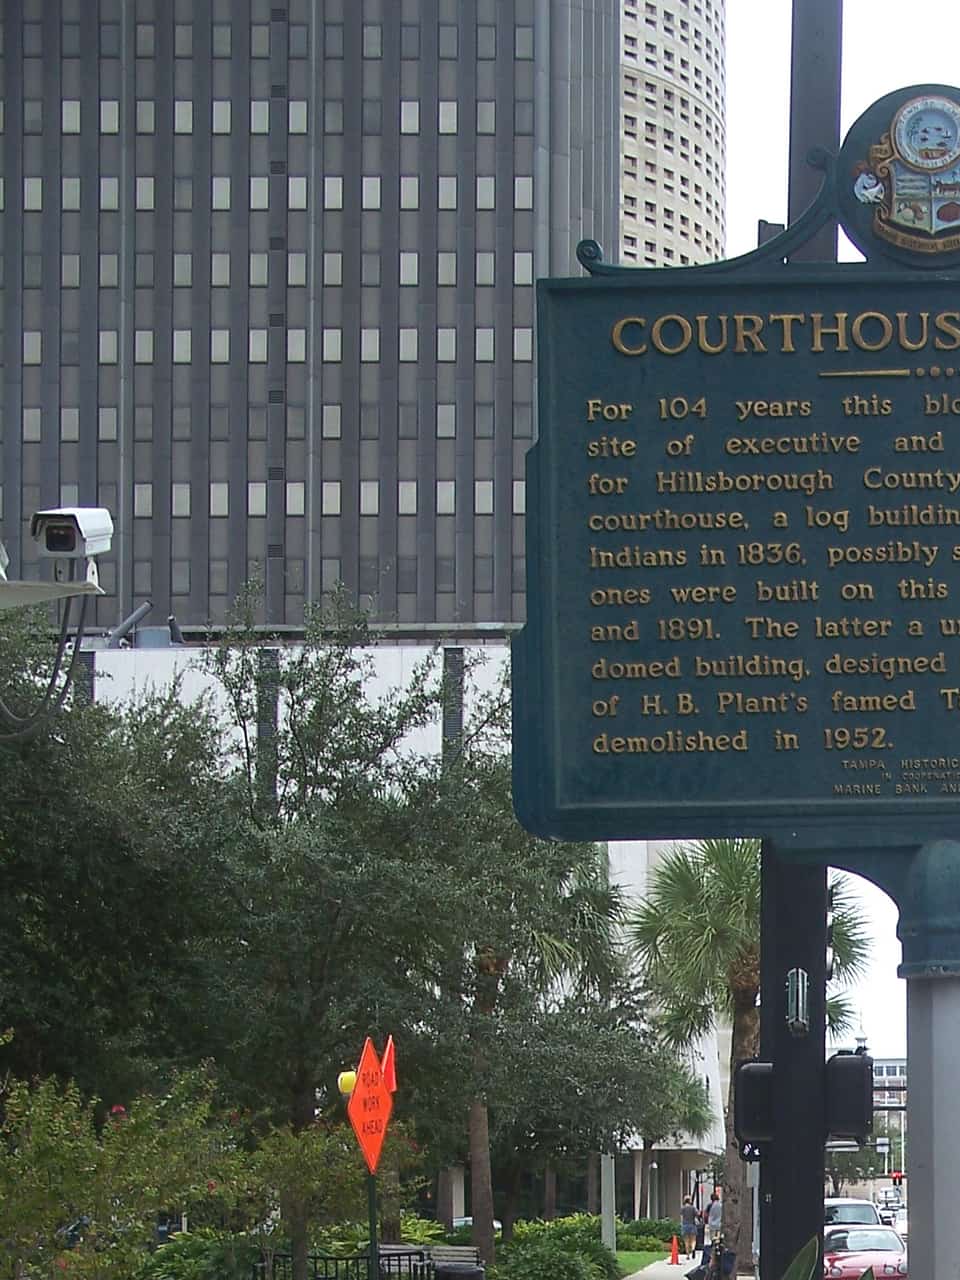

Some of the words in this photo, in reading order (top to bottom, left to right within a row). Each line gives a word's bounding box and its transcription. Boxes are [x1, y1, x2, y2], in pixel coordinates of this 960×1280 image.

[586, 399, 633, 421] For
[658, 397, 708, 419] 104
[736, 398, 812, 421] years
[842, 395, 893, 417] this
[588, 437, 637, 457] site
[666, 434, 695, 456] of
[725, 433, 861, 455] executive
[895, 431, 944, 452] and
[588, 474, 628, 496] for
[656, 469, 834, 496] Hillsborough
[588, 509, 749, 532] courthouse,
[773, 512, 788, 528] a
[806, 506, 849, 532] log
[589, 547, 687, 567] Indians
[701, 544, 726, 565] in
[737, 543, 807, 566] 1836,
[827, 541, 938, 567] possibly
[590, 587, 651, 606] ones
[671, 585, 737, 603] were
[757, 580, 819, 601] built
[841, 582, 874, 600] on
[897, 577, 948, 600] this
[591, 620, 639, 642] and
[658, 618, 721, 640] 1891.
[745, 617, 799, 639] The
[815, 616, 892, 637] latter
[907, 619, 924, 636] a
[592, 656, 681, 679] domed
[695, 655, 811, 681] building,
[825, 652, 946, 680] designed
[592, 695, 620, 717] of
[641, 695, 668, 715] H.
[678, 692, 700, 715] B.
[718, 691, 808, 713] Plant's
[831, 690, 916, 712] famed
[593, 730, 748, 754] demolished
[775, 730, 800, 751] in
[824, 727, 894, 750] 1952.
[842, 759, 886, 769] TAMPA
[832, 783, 881, 794] MARINE
[895, 783, 929, 793] BANK
